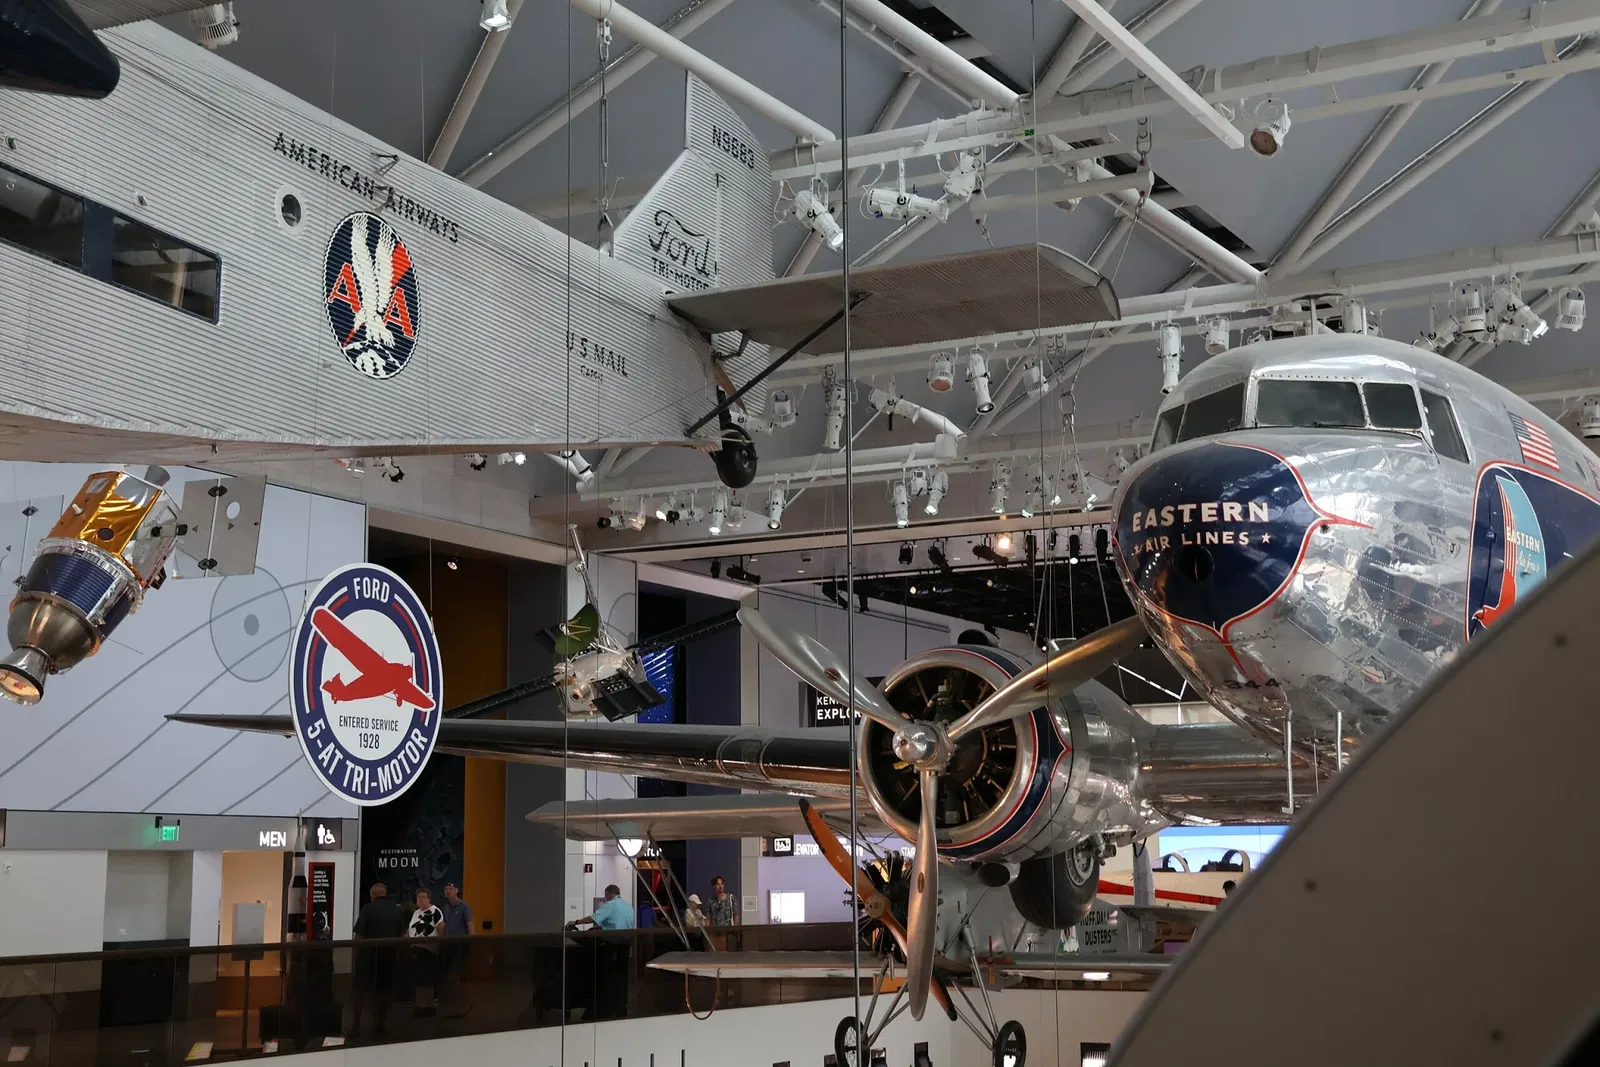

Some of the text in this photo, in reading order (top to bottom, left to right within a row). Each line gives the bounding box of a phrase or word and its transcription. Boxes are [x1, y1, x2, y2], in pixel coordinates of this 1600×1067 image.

[273, 132, 459, 243] AMERICAN AIRWAYS
[648, 209, 710, 277] Ford
[594, 344, 628, 377] MAIL
[1132, 501, 1269, 533] EASTERN
[1145, 531, 1250, 552] AIR LINES
[1506, 526, 1540, 553] EASTERN
[353, 576, 390, 603] FORD
[1224, 678, 1282, 689] 344
[339, 715, 399, 732] ENTERED SERVICE
[817, 708, 862, 720] EXPLOR
[358, 733, 380, 749] 1928
[307, 720, 428, 795] 5-AT TRI-MOTOR
[260, 831, 287, 847] MEN
[793, 843, 820, 856] EVATOR
[378, 857, 419, 868] MOON
[1085, 930, 1112, 945] DUSTERS
